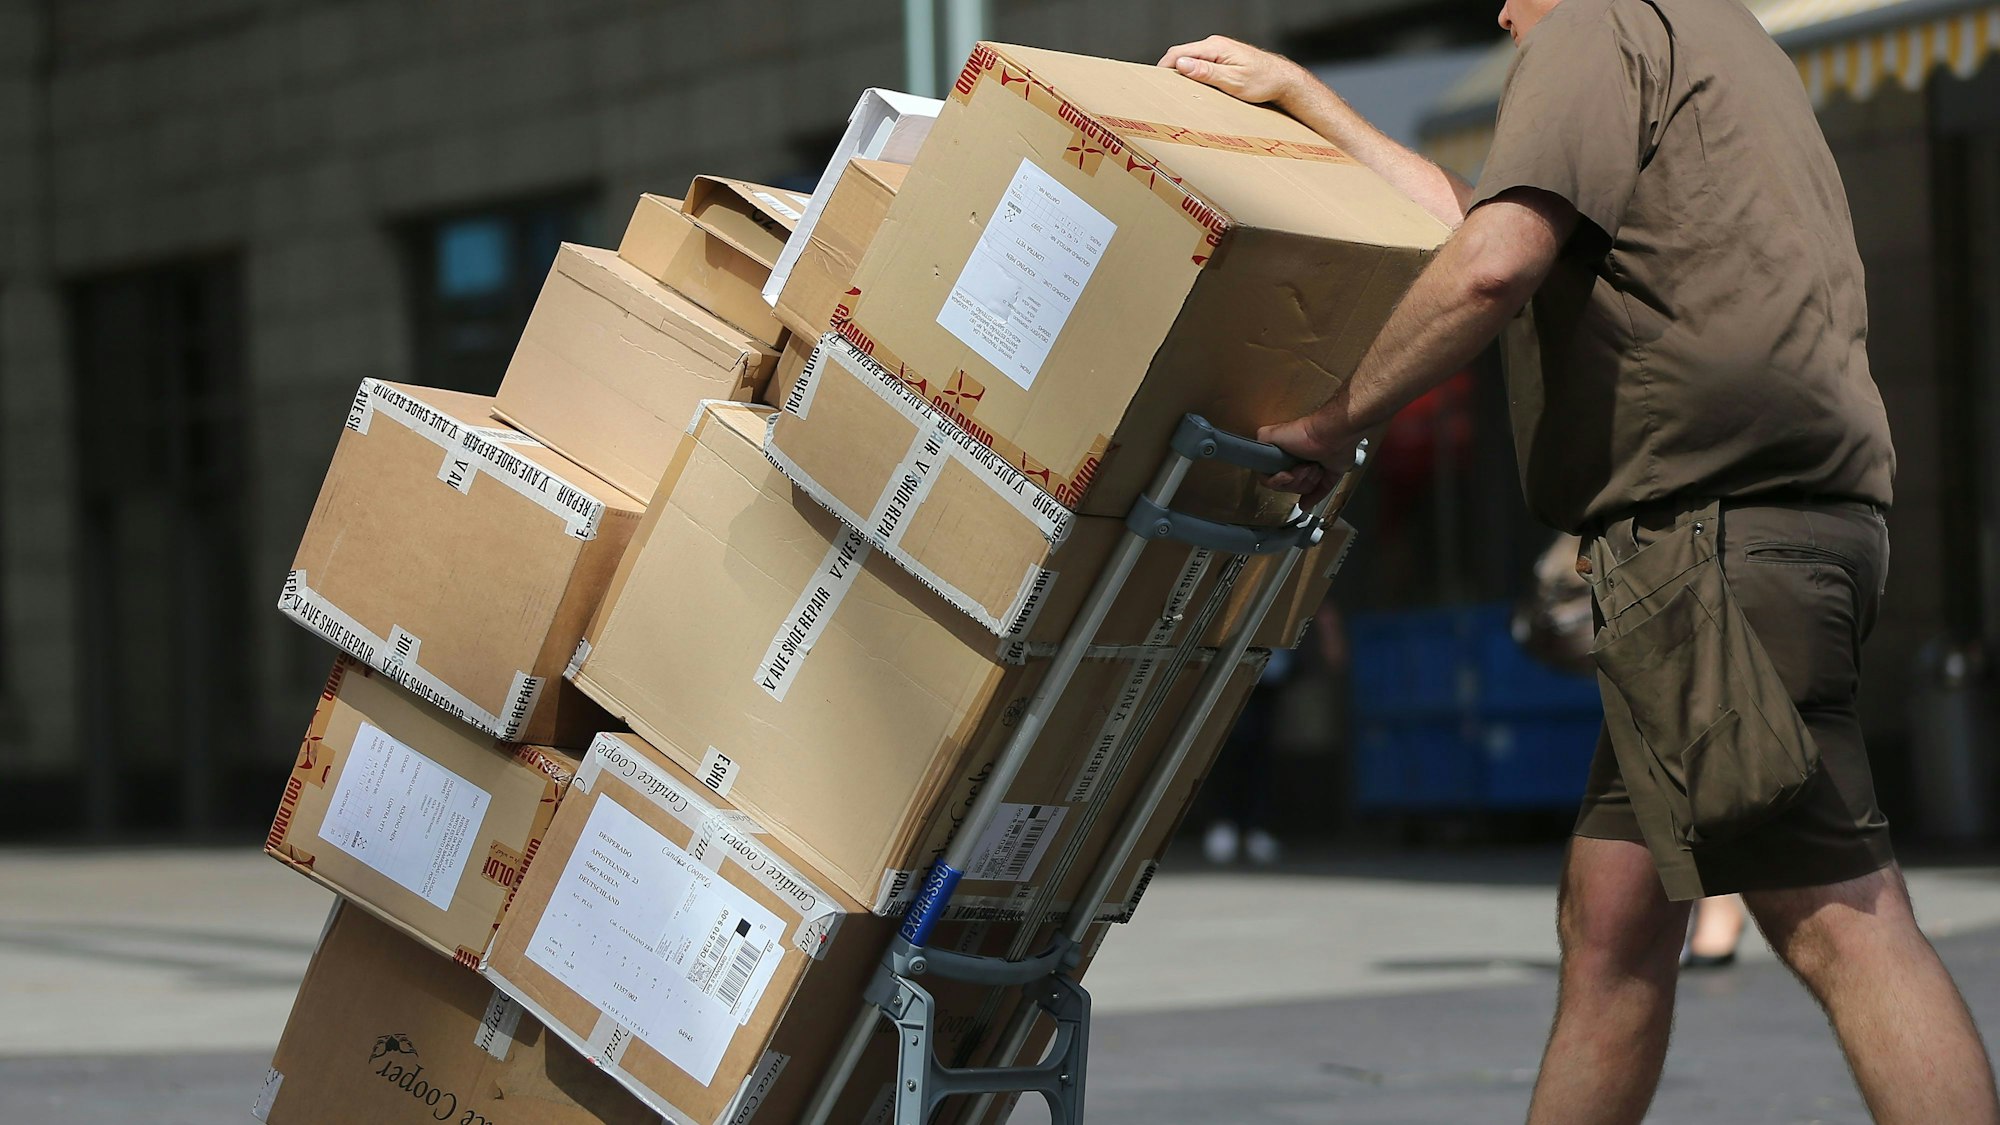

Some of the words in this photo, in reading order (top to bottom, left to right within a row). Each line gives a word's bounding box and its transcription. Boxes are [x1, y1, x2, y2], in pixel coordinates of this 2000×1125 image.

[351, 388, 370, 415] AVE
[371, 380, 408, 409] REPAIR
[345, 413, 362, 432] SH
[402, 398, 432, 423] SHOE
[427, 411, 451, 434] AVE
[459, 430, 499, 462] REPAIR
[492, 448, 523, 475] SHOE
[968, 440, 1000, 471] SHOE
[444, 469, 464, 490] AV
[515, 461, 542, 487] AVE
[991, 459, 1019, 486] AVE
[553, 483, 594, 517] REPAIR
[833, 541, 859, 570] AVE
[1179, 558, 1203, 591] SHOE
[298, 600, 322, 627] AVE
[316, 613, 345, 642] SHOE
[338, 630, 376, 664] REPAIR
[766, 651, 792, 681] AVE
[779, 622, 808, 657] SHOE
[795, 585, 832, 630] REPAIR
[387, 663, 413, 687] AVE
[1119, 686, 1139, 711] AVE
[1130, 655, 1154, 687] SHOE
[511, 678, 536, 717] REPAIR
[715, 752, 732, 766] E
[1069, 771, 1095, 805] SHOE
[1086, 730, 1116, 775] REPAIR
[634, 766, 690, 816] Candice
[703, 761, 728, 790] SHO
[597, 830, 633, 859] DESPERADO
[717, 823, 768, 872] Cooper
[598, 869, 620, 889] KOELN
[660, 843, 688, 868] Candice
[684, 861, 710, 886] Cooper
[577, 872, 621, 907] DEUTSCHLAND
[764, 861, 819, 912] Candice
[899, 863, 951, 940] EXPRESSO
[699, 939, 712, 959] DEU
[708, 924, 720, 941] 510
[716, 907, 729, 927] 9-00
[709, 953, 728, 984] STANDARD
[368, 1048, 466, 1125] Cooper
